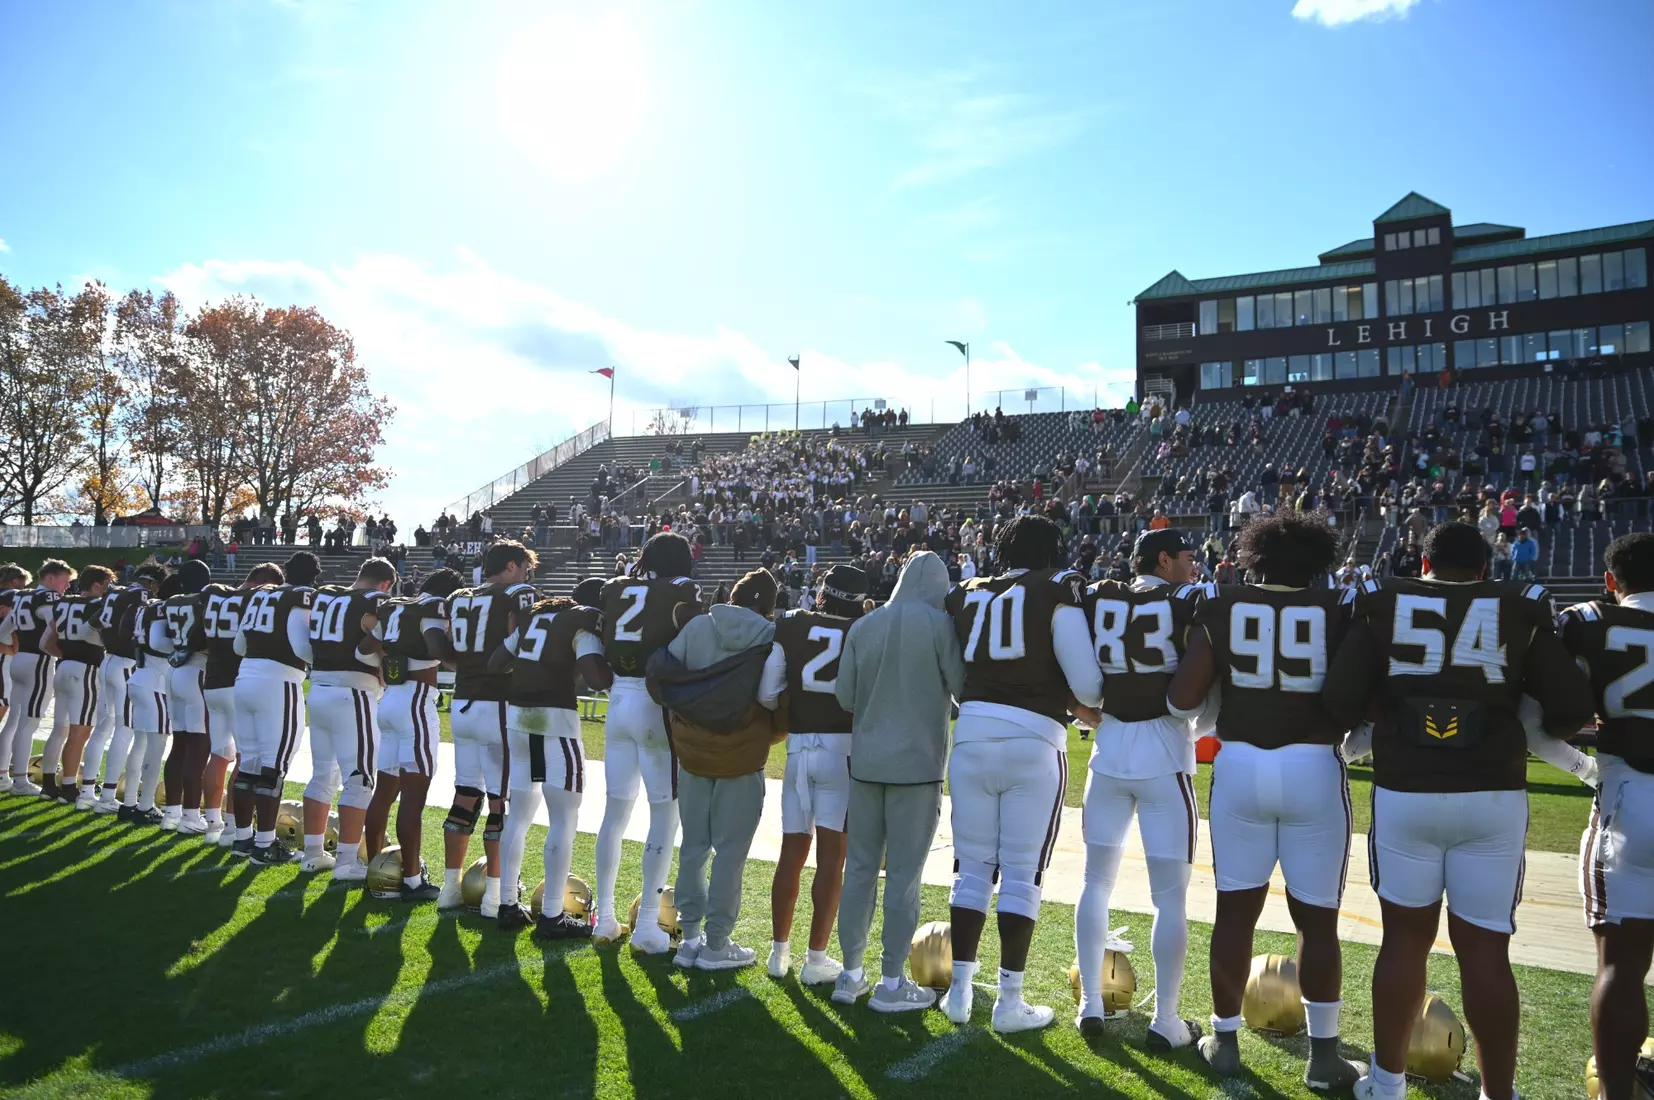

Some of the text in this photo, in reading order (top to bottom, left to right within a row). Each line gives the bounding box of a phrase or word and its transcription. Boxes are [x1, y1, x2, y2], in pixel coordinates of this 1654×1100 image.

[1328, 311, 1509, 346] LEHIGH
[56, 602, 87, 640] 26
[166, 605, 195, 646] 57
[204, 594, 244, 638] 55
[240, 591, 284, 633] 66
[310, 593, 352, 642] 50
[451, 595, 493, 652] 67
[518, 612, 557, 661] 5
[614, 585, 649, 641] 2
[963, 585, 1025, 662] 70
[1095, 598, 1179, 674] 83
[1229, 602, 1328, 692] 99
[1388, 593, 1507, 684] 54
